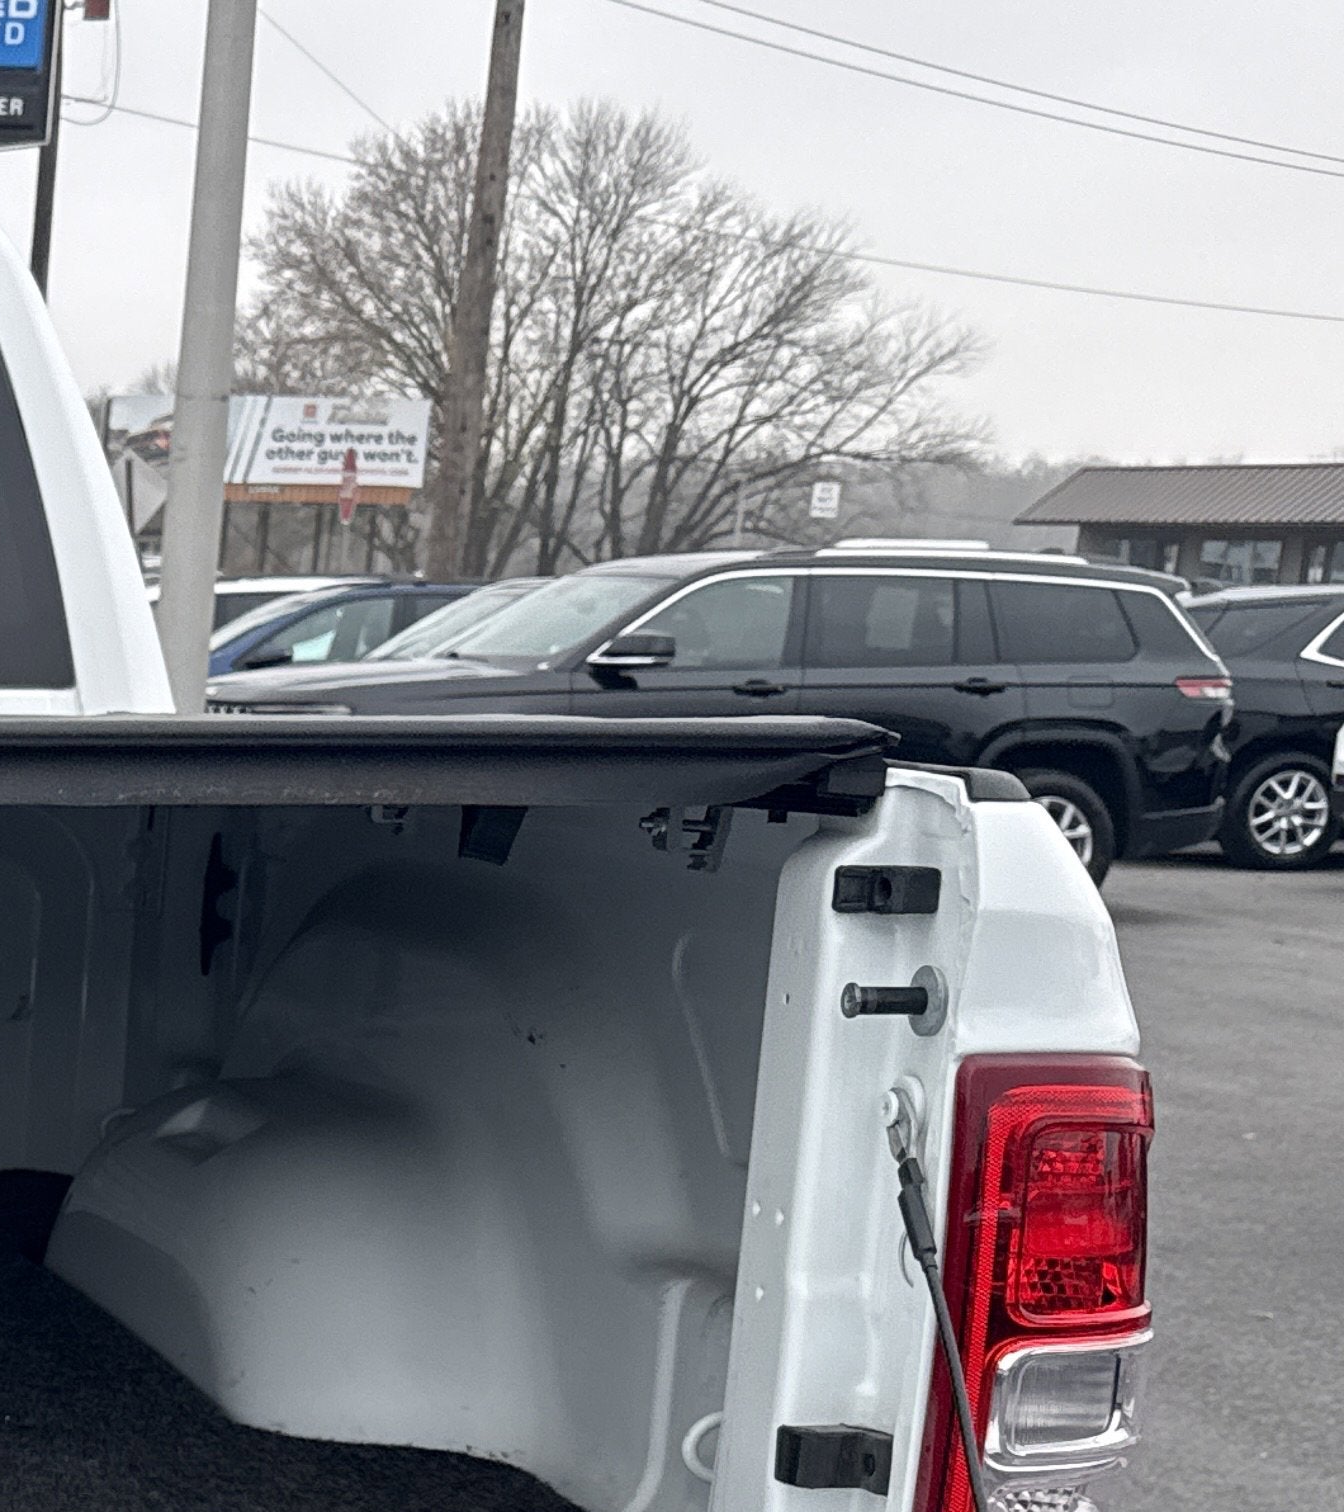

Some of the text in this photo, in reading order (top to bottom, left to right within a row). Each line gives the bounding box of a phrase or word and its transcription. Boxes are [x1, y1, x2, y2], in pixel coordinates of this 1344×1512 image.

[271, 427, 418, 447] Going where the
[265, 446, 314, 460] other
